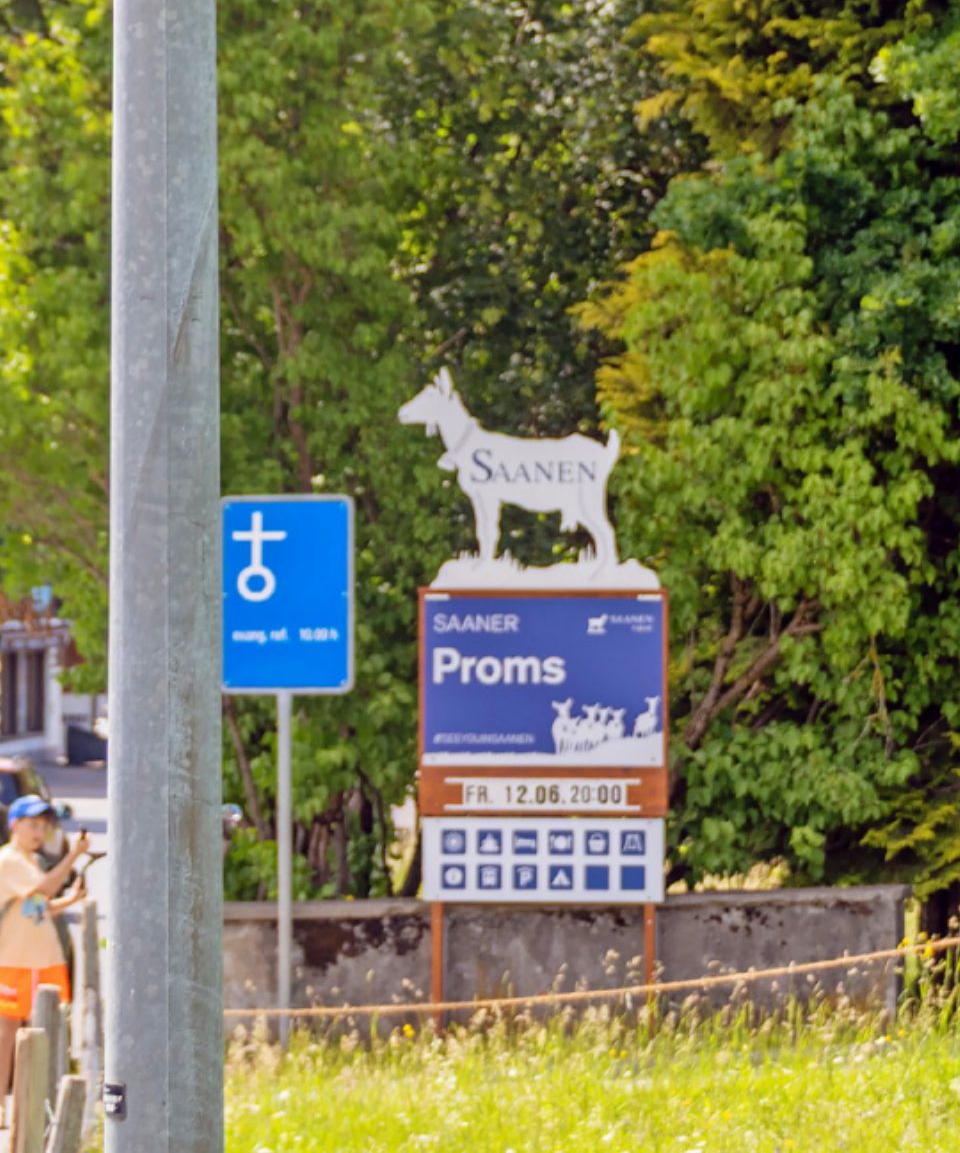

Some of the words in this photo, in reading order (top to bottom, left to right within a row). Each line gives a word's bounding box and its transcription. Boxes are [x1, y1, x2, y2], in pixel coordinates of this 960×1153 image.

[433, 613, 520, 634] SAANER
[433, 647, 566, 685] Proms
[465, 784, 493, 804] FR.
